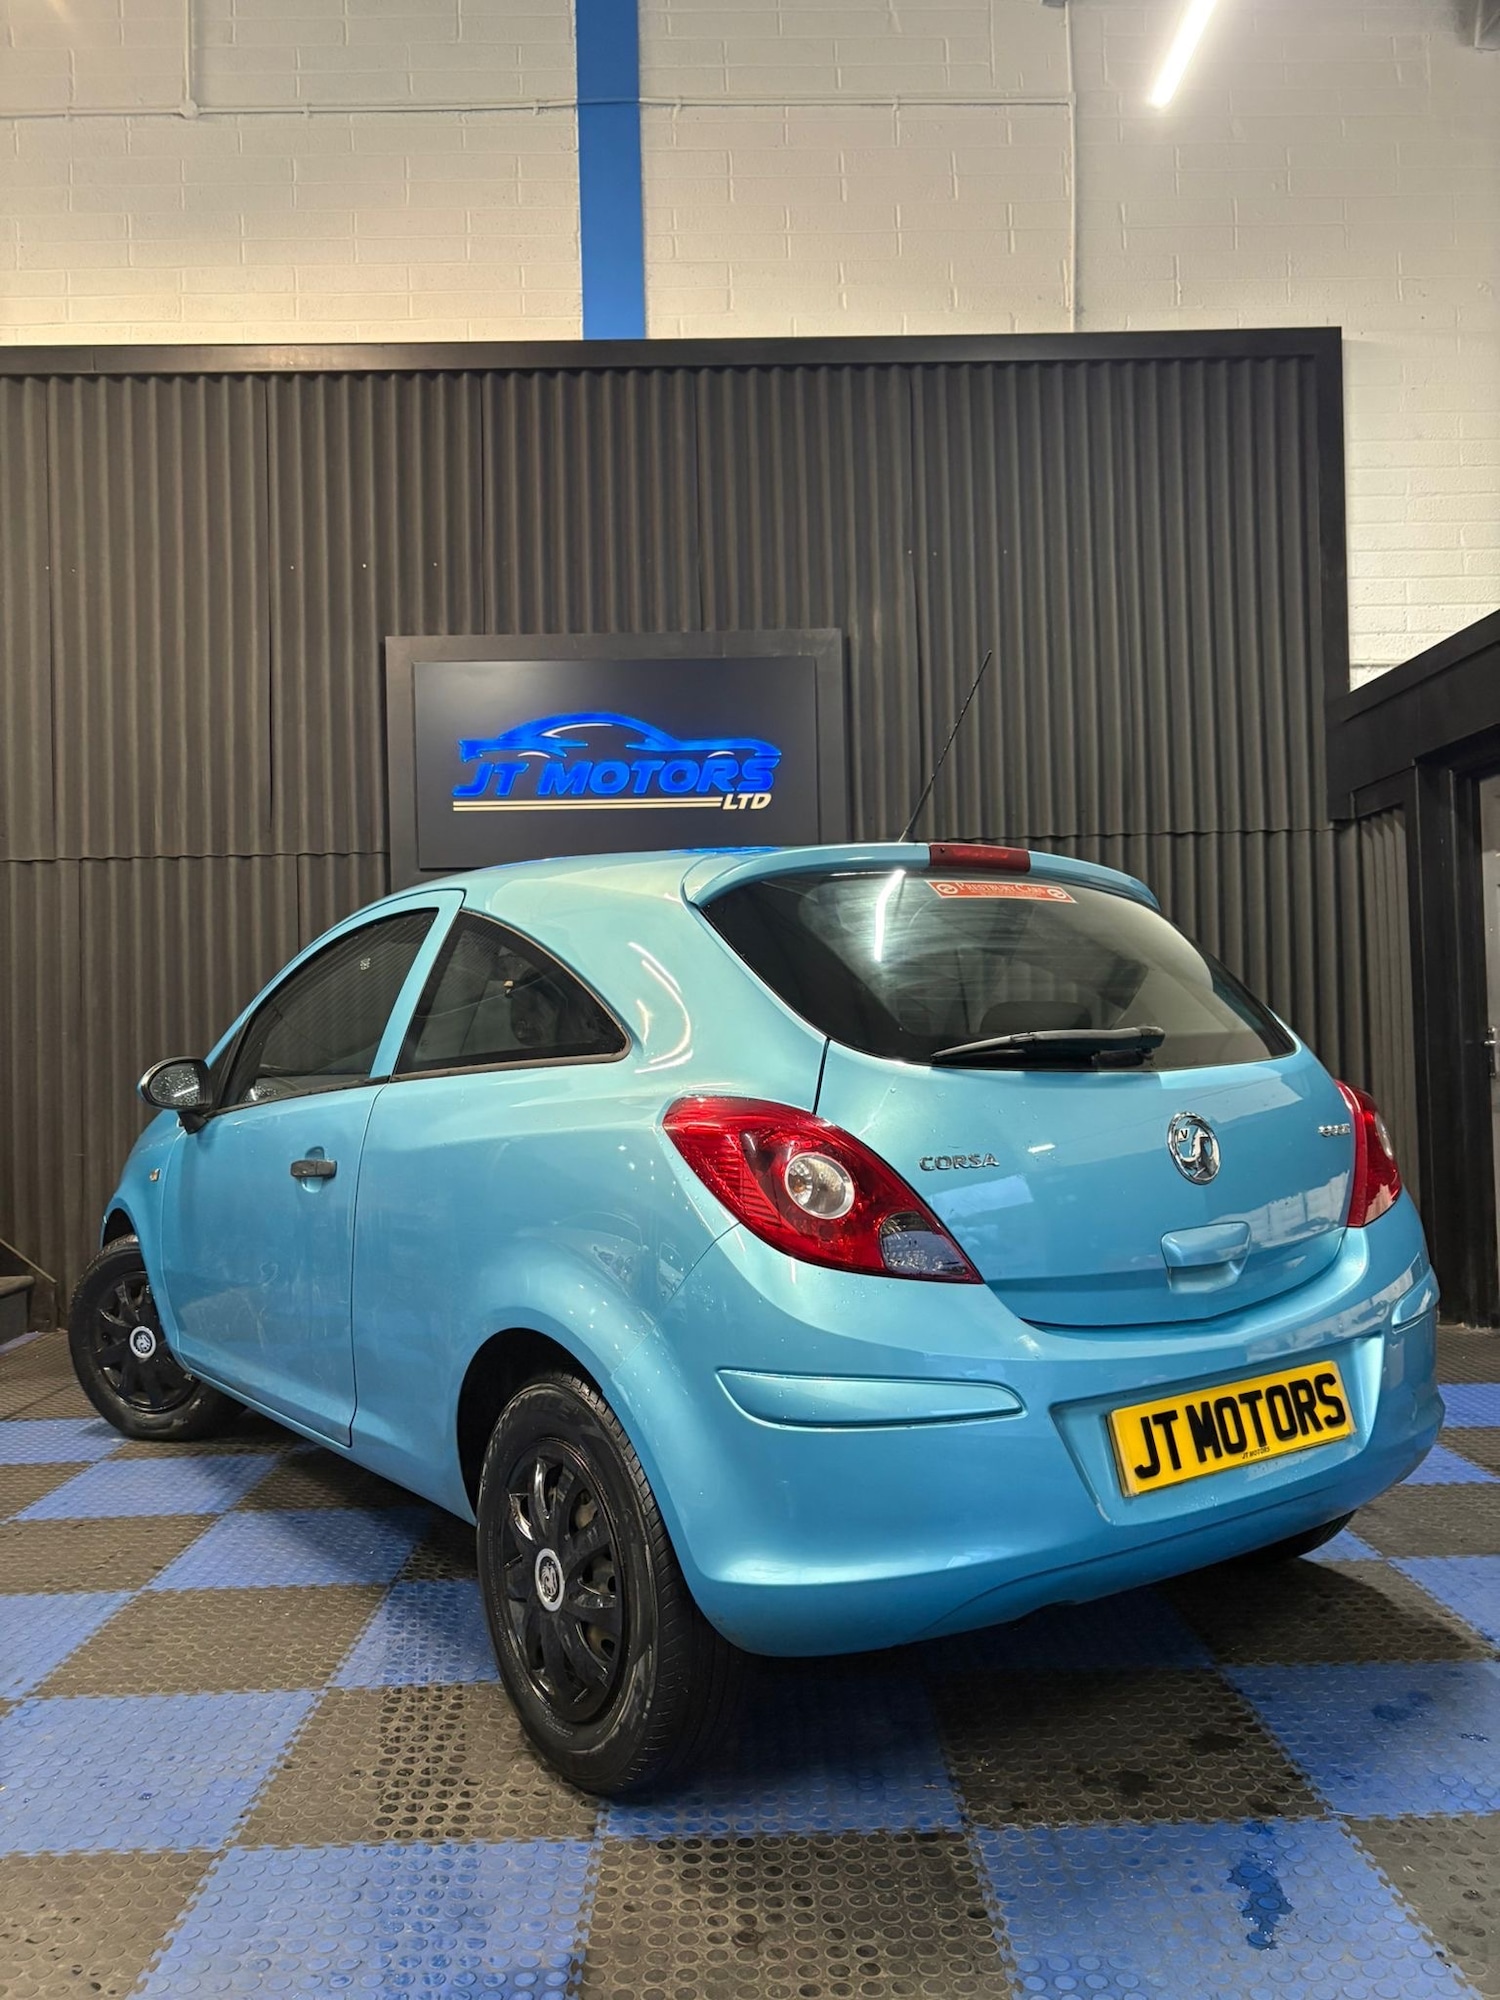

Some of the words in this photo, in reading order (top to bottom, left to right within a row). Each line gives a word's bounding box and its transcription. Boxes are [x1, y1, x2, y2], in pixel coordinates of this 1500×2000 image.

[453, 762, 529, 796] JT
[537, 758, 782, 796] MOTORS
[722, 793, 772, 810] LTD
[919, 1152, 1000, 1171] CORSA
[1134, 1409, 1182, 1479] JT
[1185, 1373, 1347, 1464] MOTORS
[1241, 1451, 1249, 1460] JT
[1249, 1445, 1271, 1458] MOTORS
